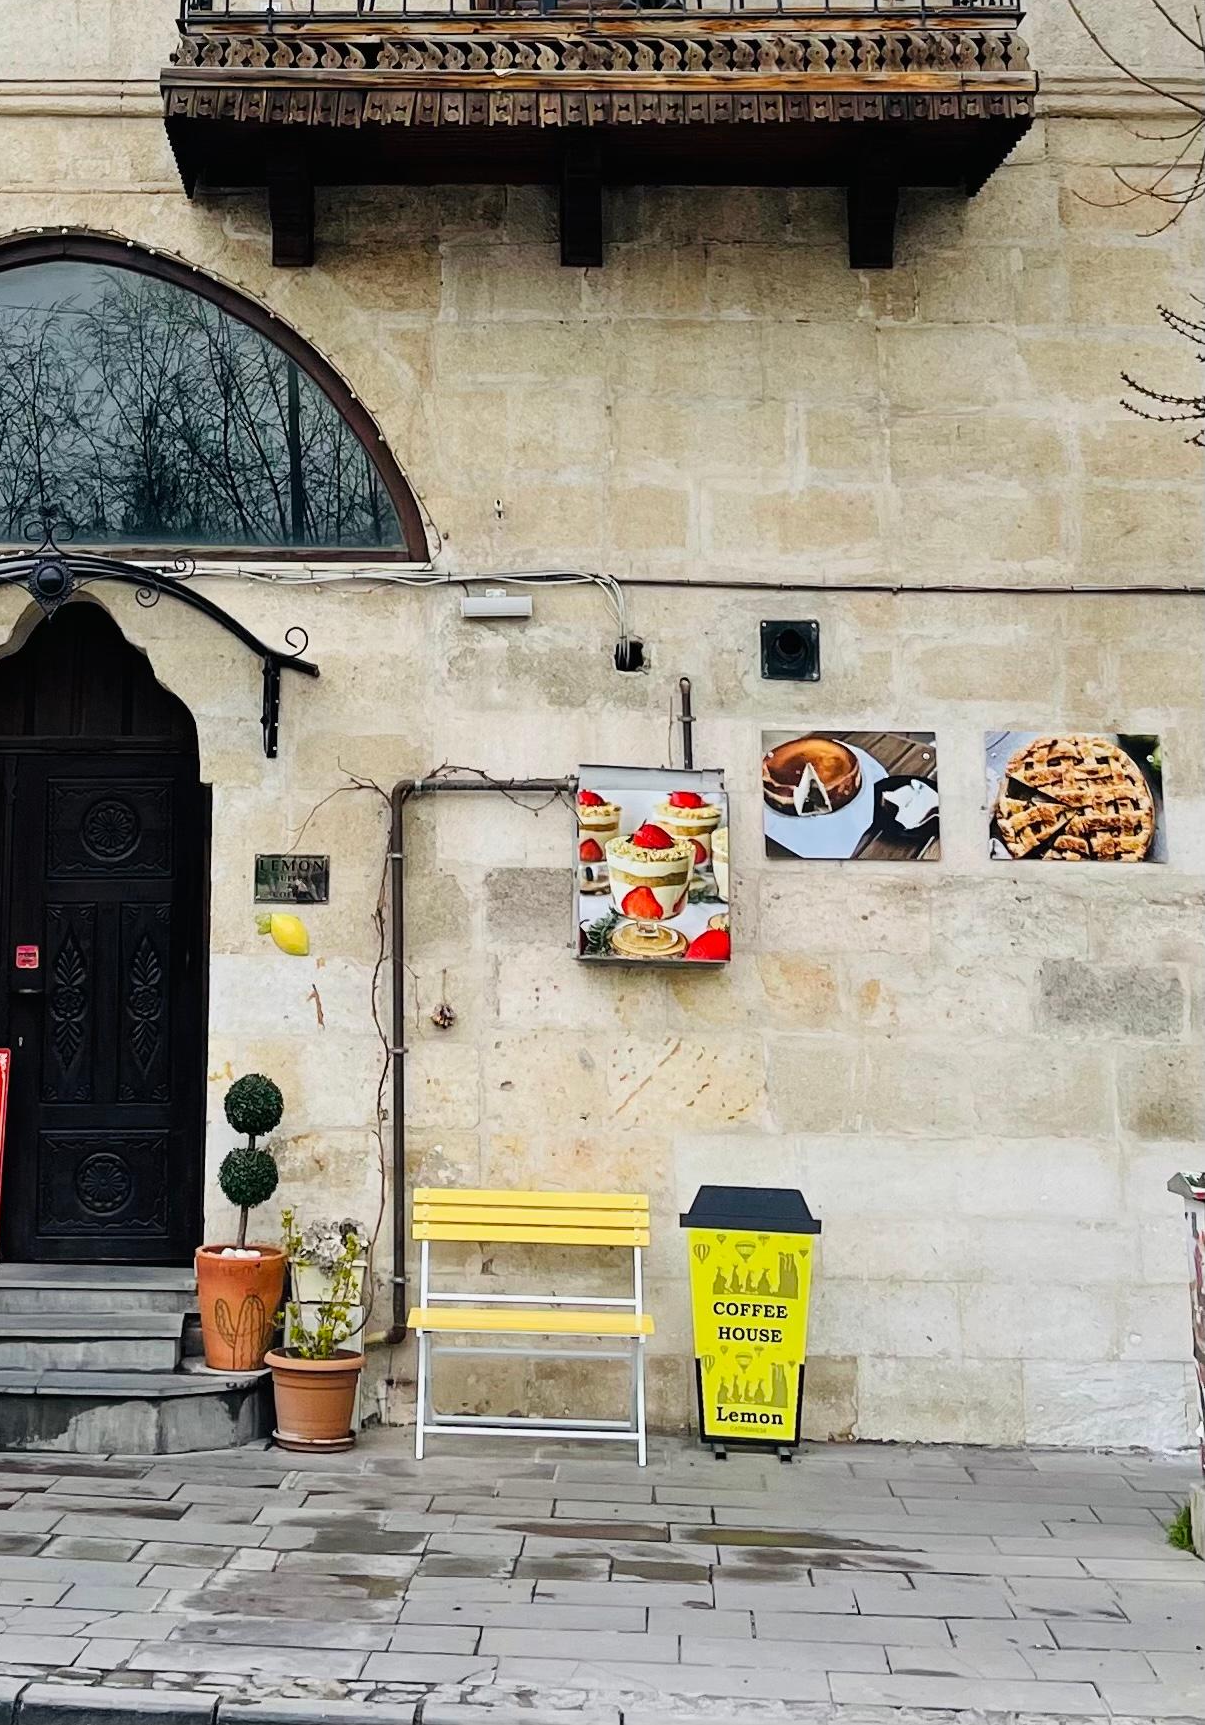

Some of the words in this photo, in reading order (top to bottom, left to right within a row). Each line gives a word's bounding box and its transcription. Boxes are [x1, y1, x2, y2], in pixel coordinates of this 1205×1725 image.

[259, 859, 325, 872] LEMON
[713, 1302, 788, 1319] COFFEE
[717, 1326, 782, 1343] HOUSE
[716, 1406, 784, 1425] Lemon
